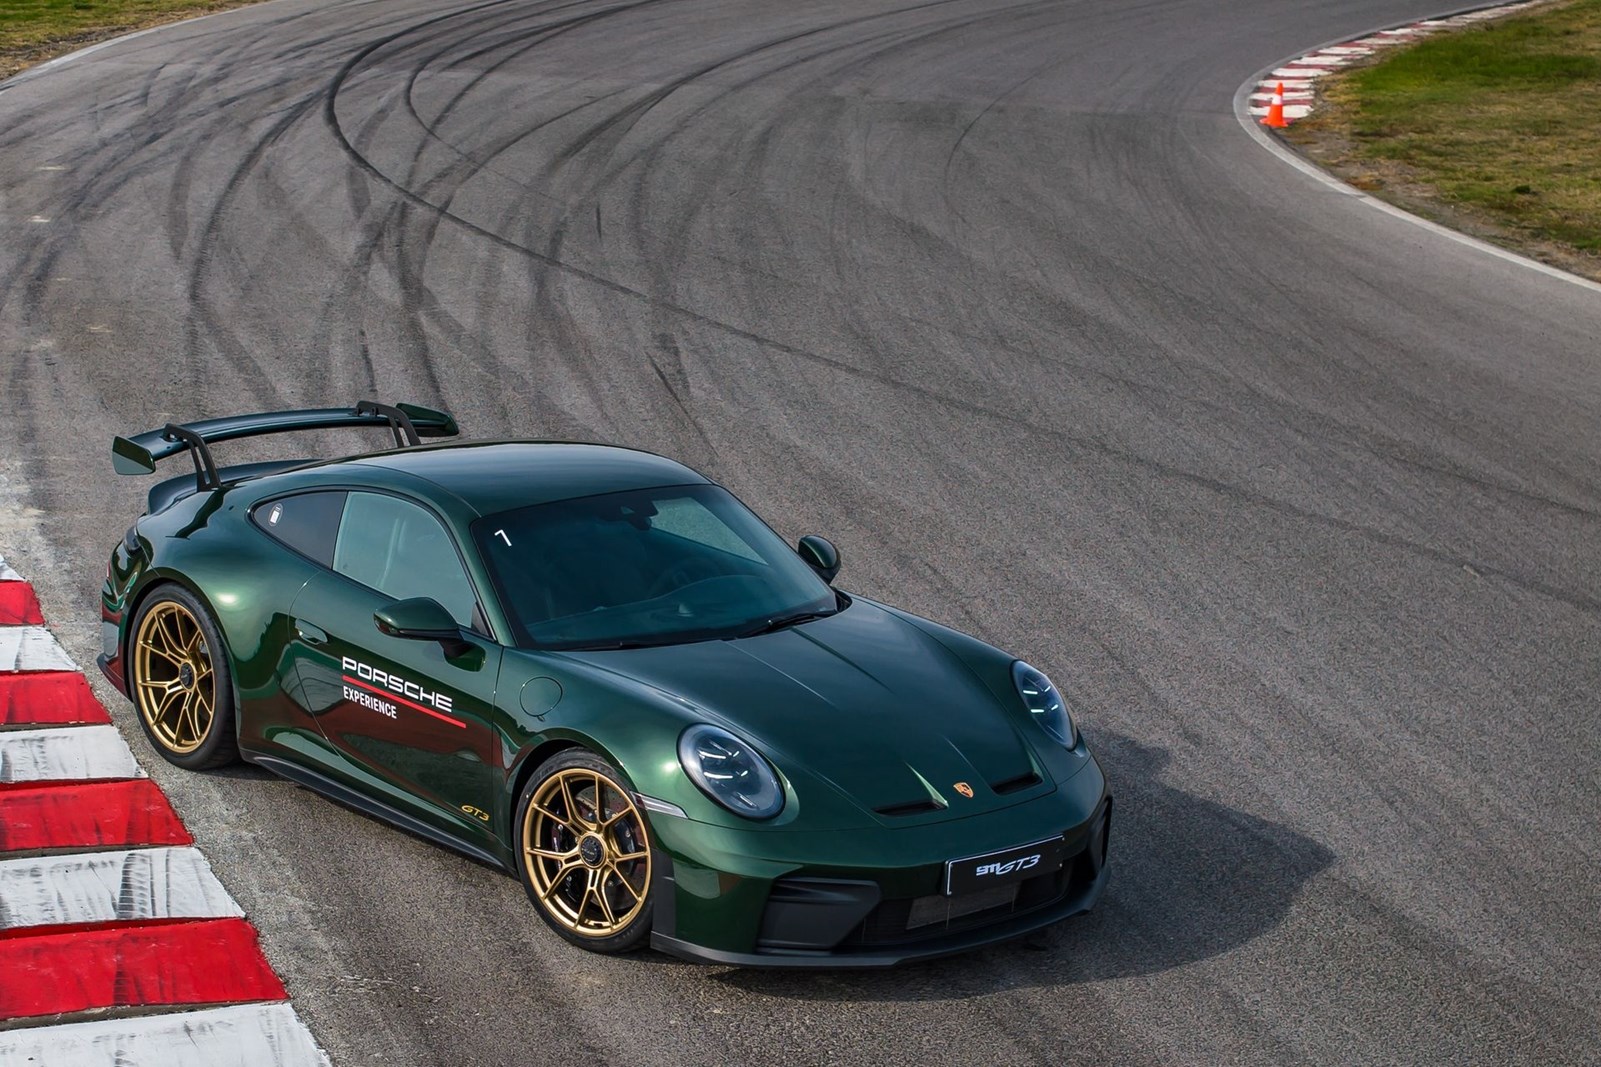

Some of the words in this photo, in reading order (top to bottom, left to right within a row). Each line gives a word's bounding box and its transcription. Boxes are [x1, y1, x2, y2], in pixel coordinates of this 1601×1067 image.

[342, 656, 453, 713] PORSCHE
[342, 685, 398, 720] EXPERIENCE
[461, 804, 490, 821] GT3
